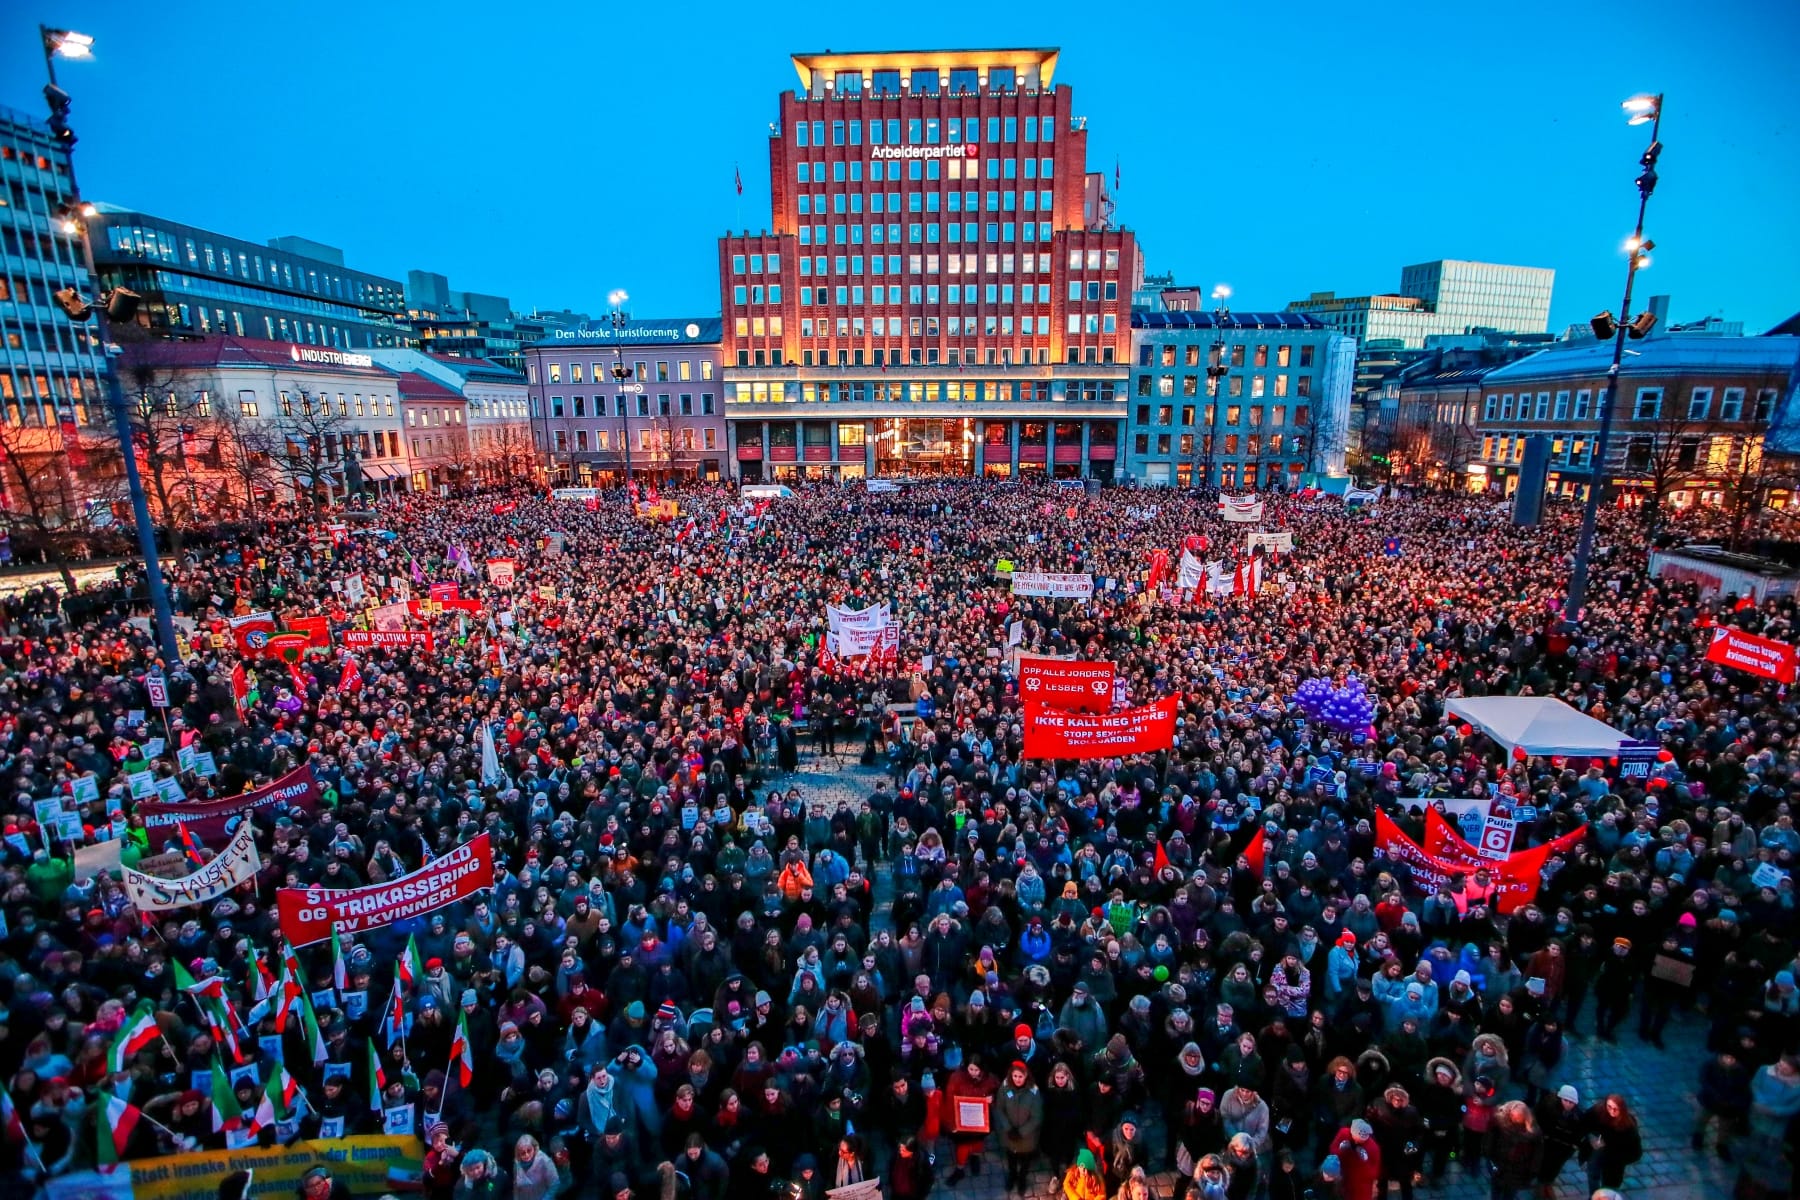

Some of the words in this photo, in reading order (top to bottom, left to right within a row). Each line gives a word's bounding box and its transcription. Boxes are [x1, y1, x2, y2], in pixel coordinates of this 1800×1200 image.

[871, 144, 966, 160] Arbeiderpartiet
[555, 329, 575, 338] Den
[578, 328, 611, 338] Norske
[613, 328, 679, 340] Turistforening
[347, 632, 368, 642] AKTIV
[371, 632, 407, 642] POLITIKK
[887, 628, 897, 639] 5
[1728, 636, 1761, 654] Kvinners
[1761, 645, 1784, 663] kropp,
[1725, 649, 1759, 667] kvinners
[1759, 660, 1777, 675] valg
[1023, 667, 1041, 675] OPP
[1042, 669, 1066, 677] ALLE
[1067, 670, 1111, 678] JORDENS
[151, 686, 163, 700] 3
[1045, 683, 1085, 693] LESBER
[1035, 716, 1064, 727] IKKE
[1067, 718, 1099, 727] KALL
[1102, 717, 1129, 727] MEG
[1063, 730, 1093, 738] STOPP
[1486, 817, 1513, 829] Pulje
[1486, 830, 1506, 850] 6
[300, 908, 328, 923] OG
[333, 858, 480, 917] TRAKASSERING
[334, 918, 360, 934] AV
[367, 886, 459, 926] KVINNER!
[173, 1159, 226, 1177] iranske
[229, 1154, 280, 1171] kvinner
[284, 1152, 312, 1165] som
